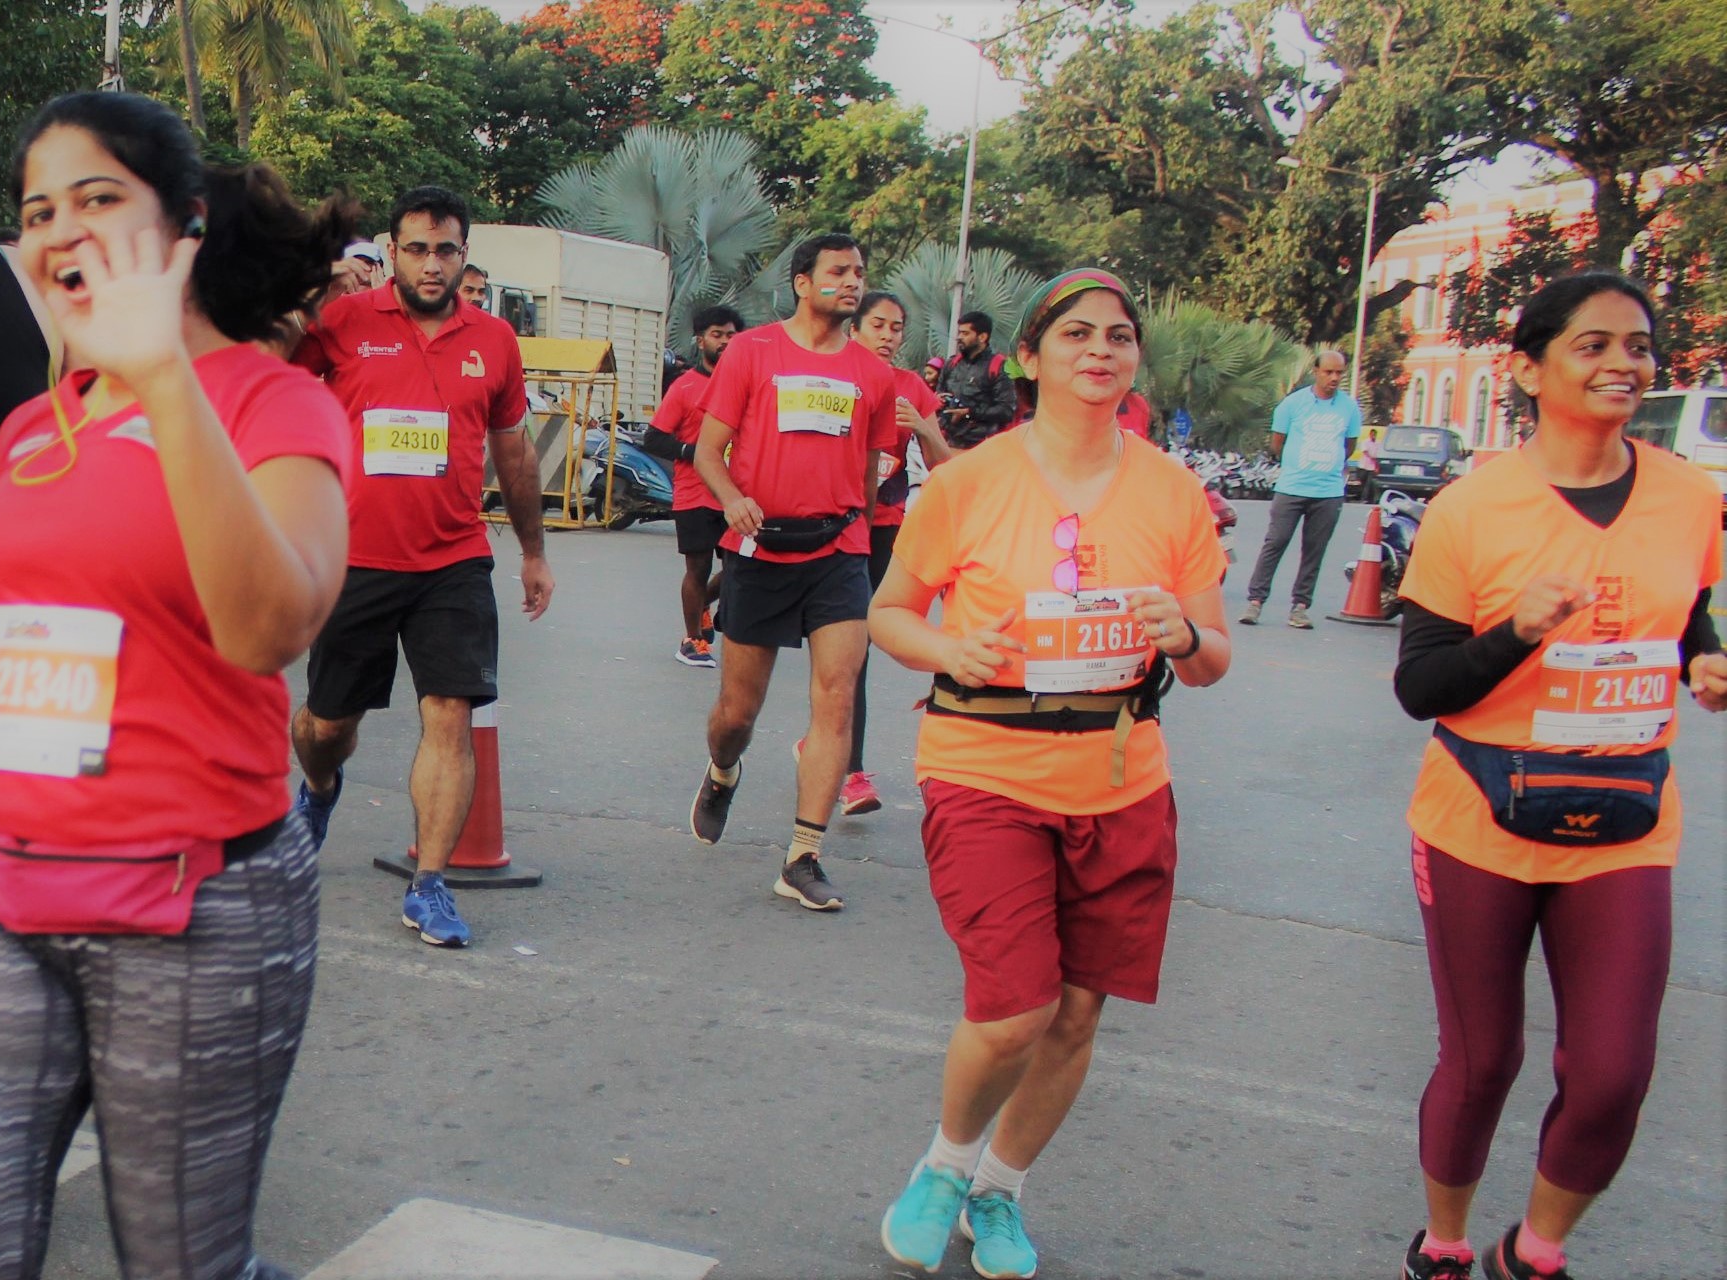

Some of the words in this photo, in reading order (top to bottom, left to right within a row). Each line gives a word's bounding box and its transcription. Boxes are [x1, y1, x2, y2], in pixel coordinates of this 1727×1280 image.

[807, 394, 848, 414] 24082
[390, 430, 440, 450] 24310
[1037, 635, 1053, 648] HM
[1076, 621, 1148, 654] 21612
[1549, 686, 1569, 699] HM
[1591, 673, 1667, 708] 21420
